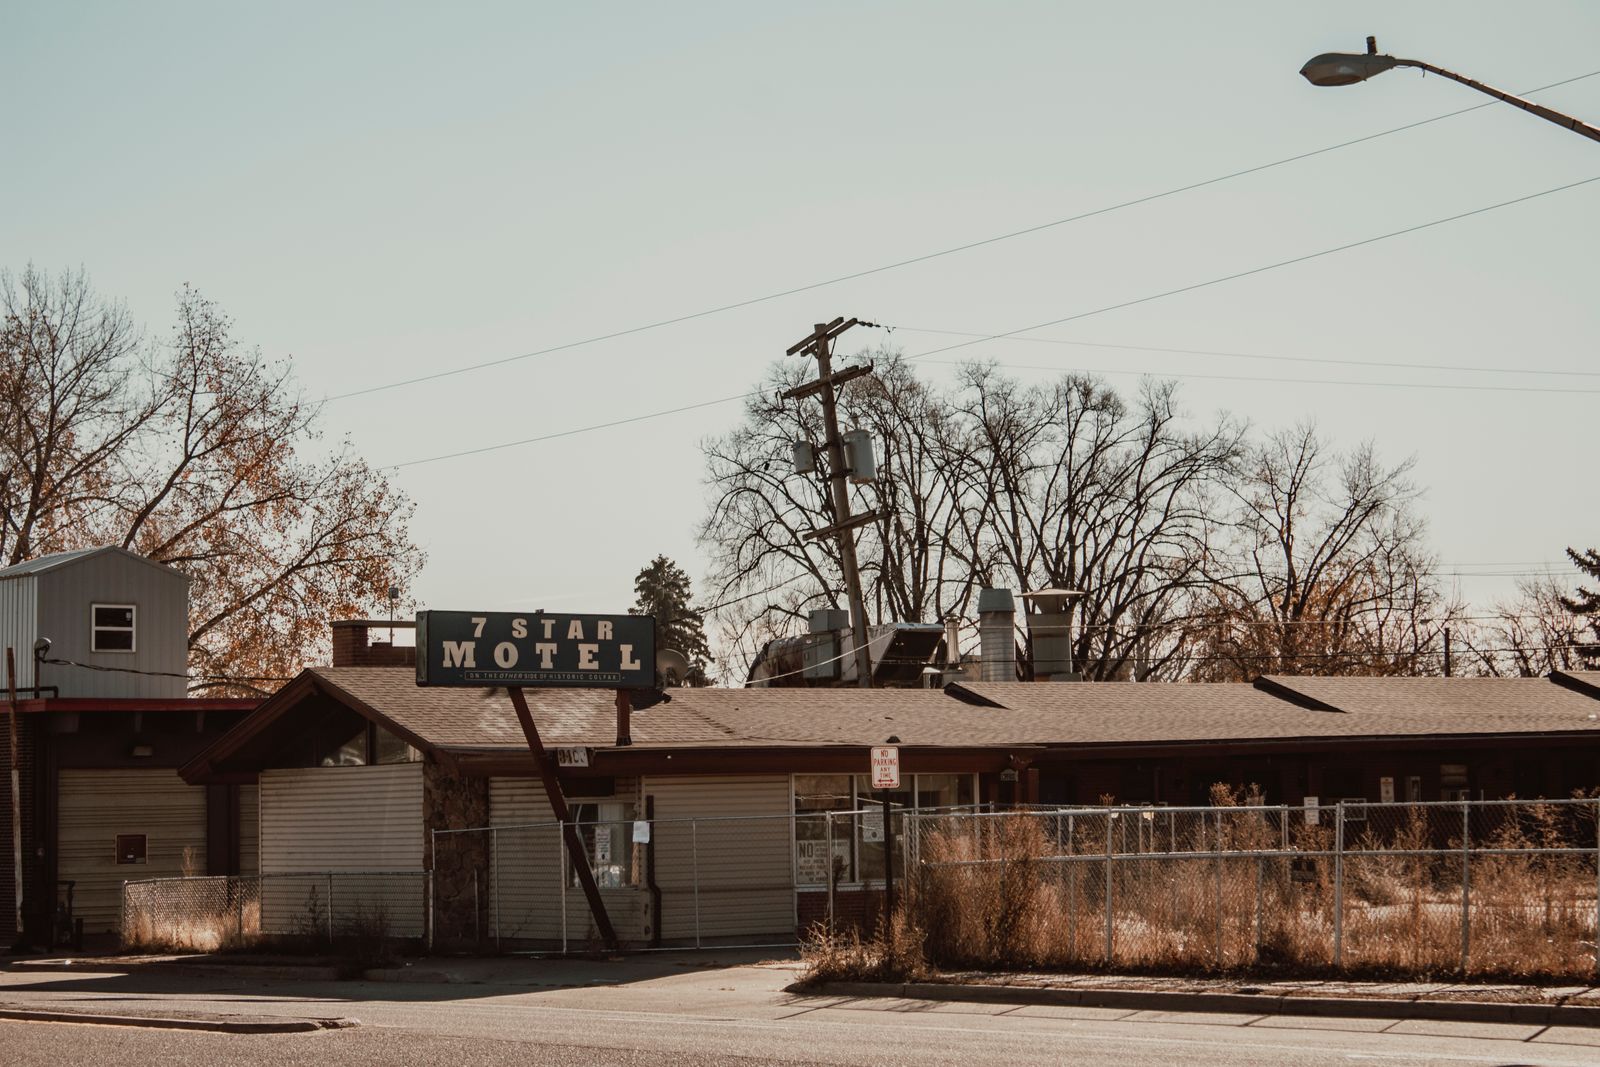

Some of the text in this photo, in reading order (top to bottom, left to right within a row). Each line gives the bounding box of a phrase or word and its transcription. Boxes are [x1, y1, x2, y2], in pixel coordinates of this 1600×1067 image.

[471, 617, 614, 640] 7 STAR
[442, 640, 641, 671] MOTEL
[873, 758, 897, 766] PARKING
[880, 750, 889, 758] NO
[799, 842, 814, 858] NO
